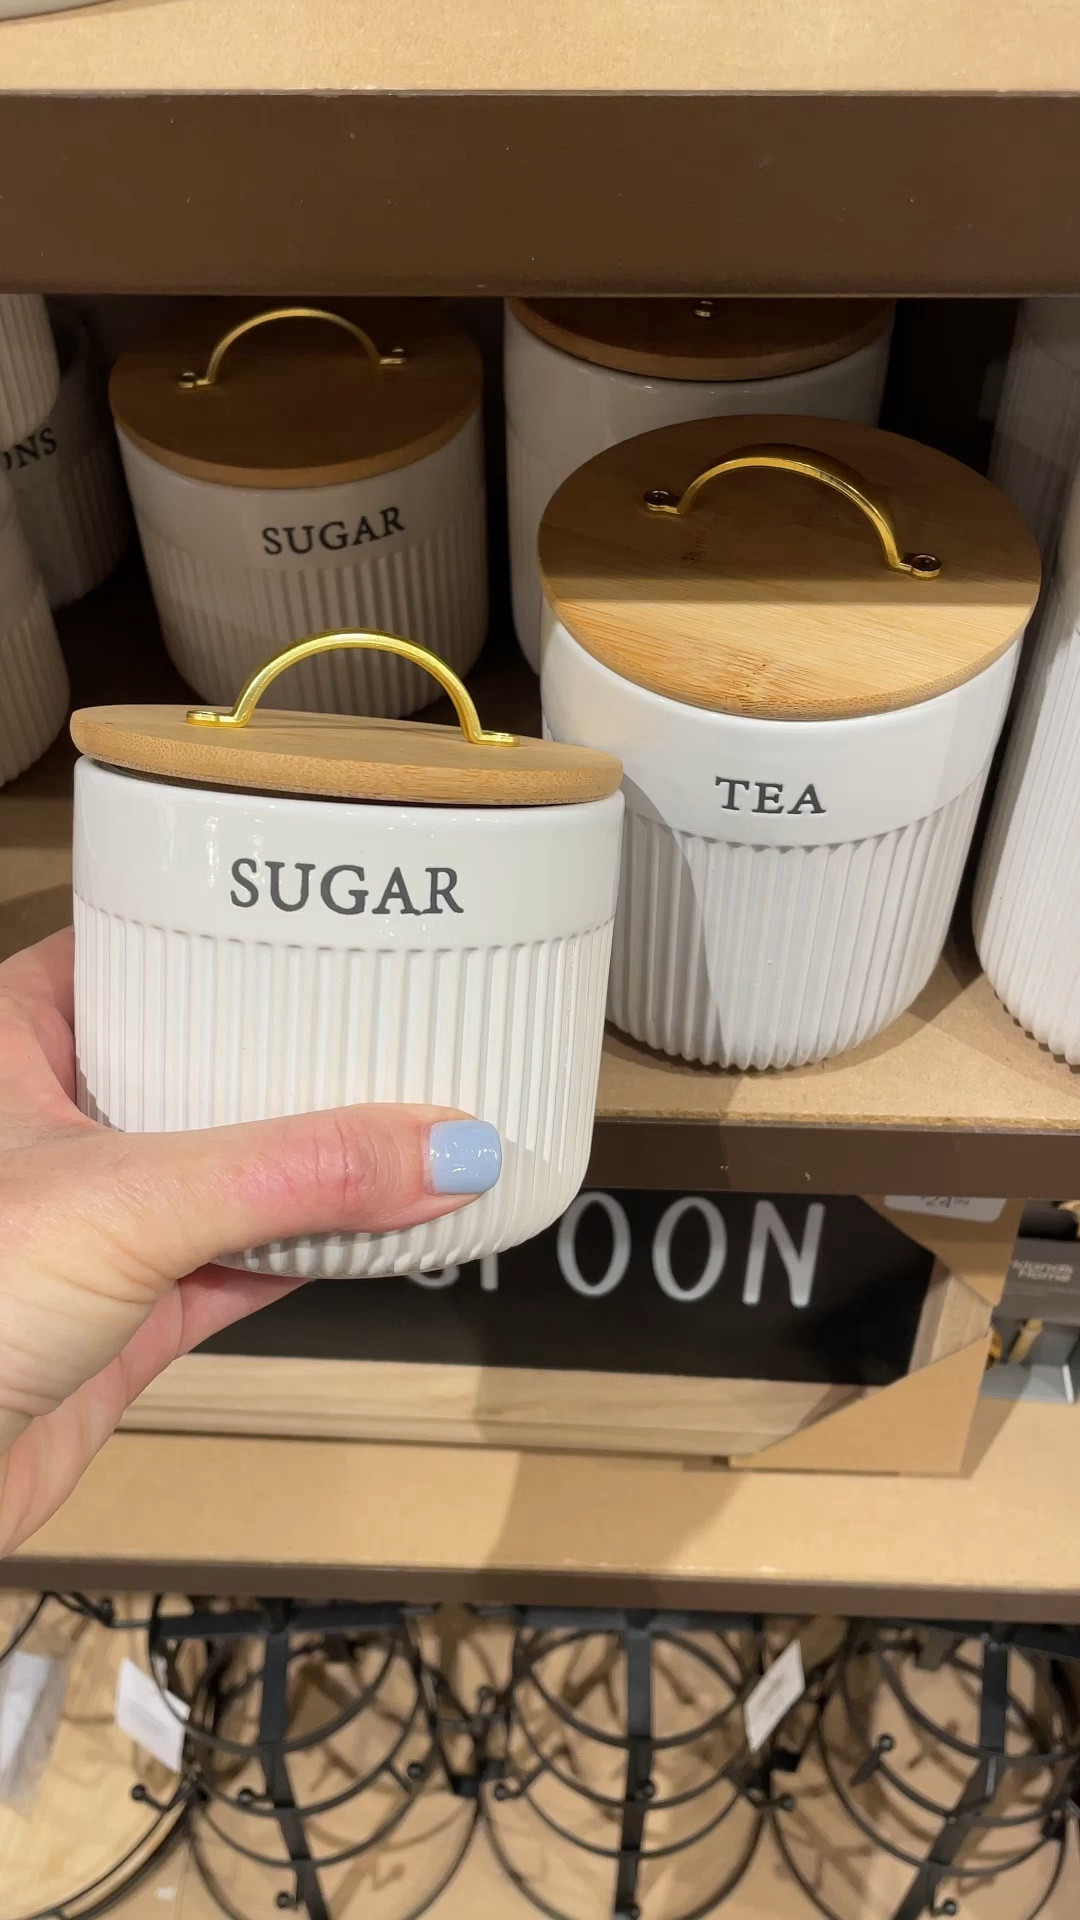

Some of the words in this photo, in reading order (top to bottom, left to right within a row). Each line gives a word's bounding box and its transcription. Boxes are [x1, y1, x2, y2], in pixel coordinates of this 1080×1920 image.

[262, 506, 406, 555] SUGAR
[715, 775, 827, 815] TEA
[230, 857, 465, 916] SUGAR
[407, 1191, 826, 1308] OON
